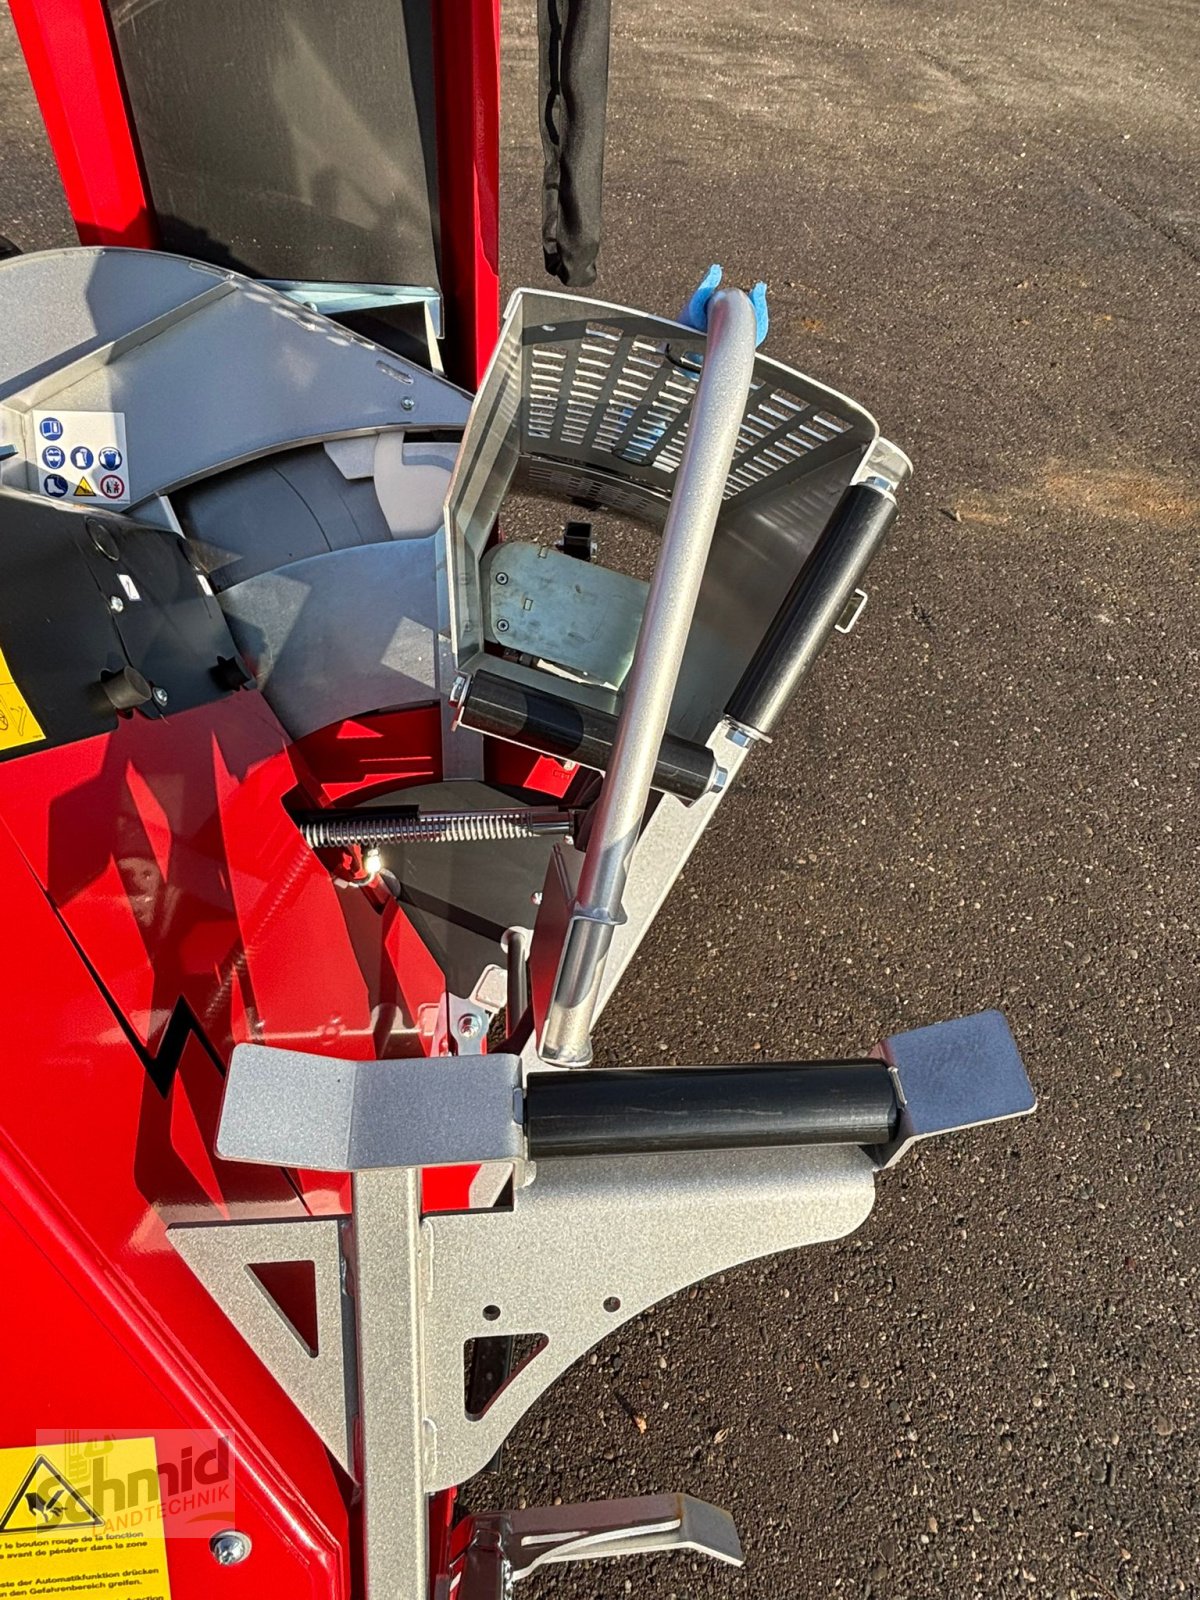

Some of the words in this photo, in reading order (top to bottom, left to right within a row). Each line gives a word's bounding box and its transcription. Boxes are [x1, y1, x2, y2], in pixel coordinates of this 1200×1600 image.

[16, 1540, 49, 1549] bouton
[81, 1535, 92, 1543] de
[106, 1532, 144, 1540] fonction
[7, 1551, 32, 1559] avant
[49, 1547, 88, 1557] pénétrer
[17, 1579, 33, 1587] der
[35, 1572, 120, 1585] Automatikfunktion
[122, 1568, 159, 1577] drücken
[29, 1582, 106, 1595] Gefahrenbereich
[108, 1579, 143, 1589] greifen.
